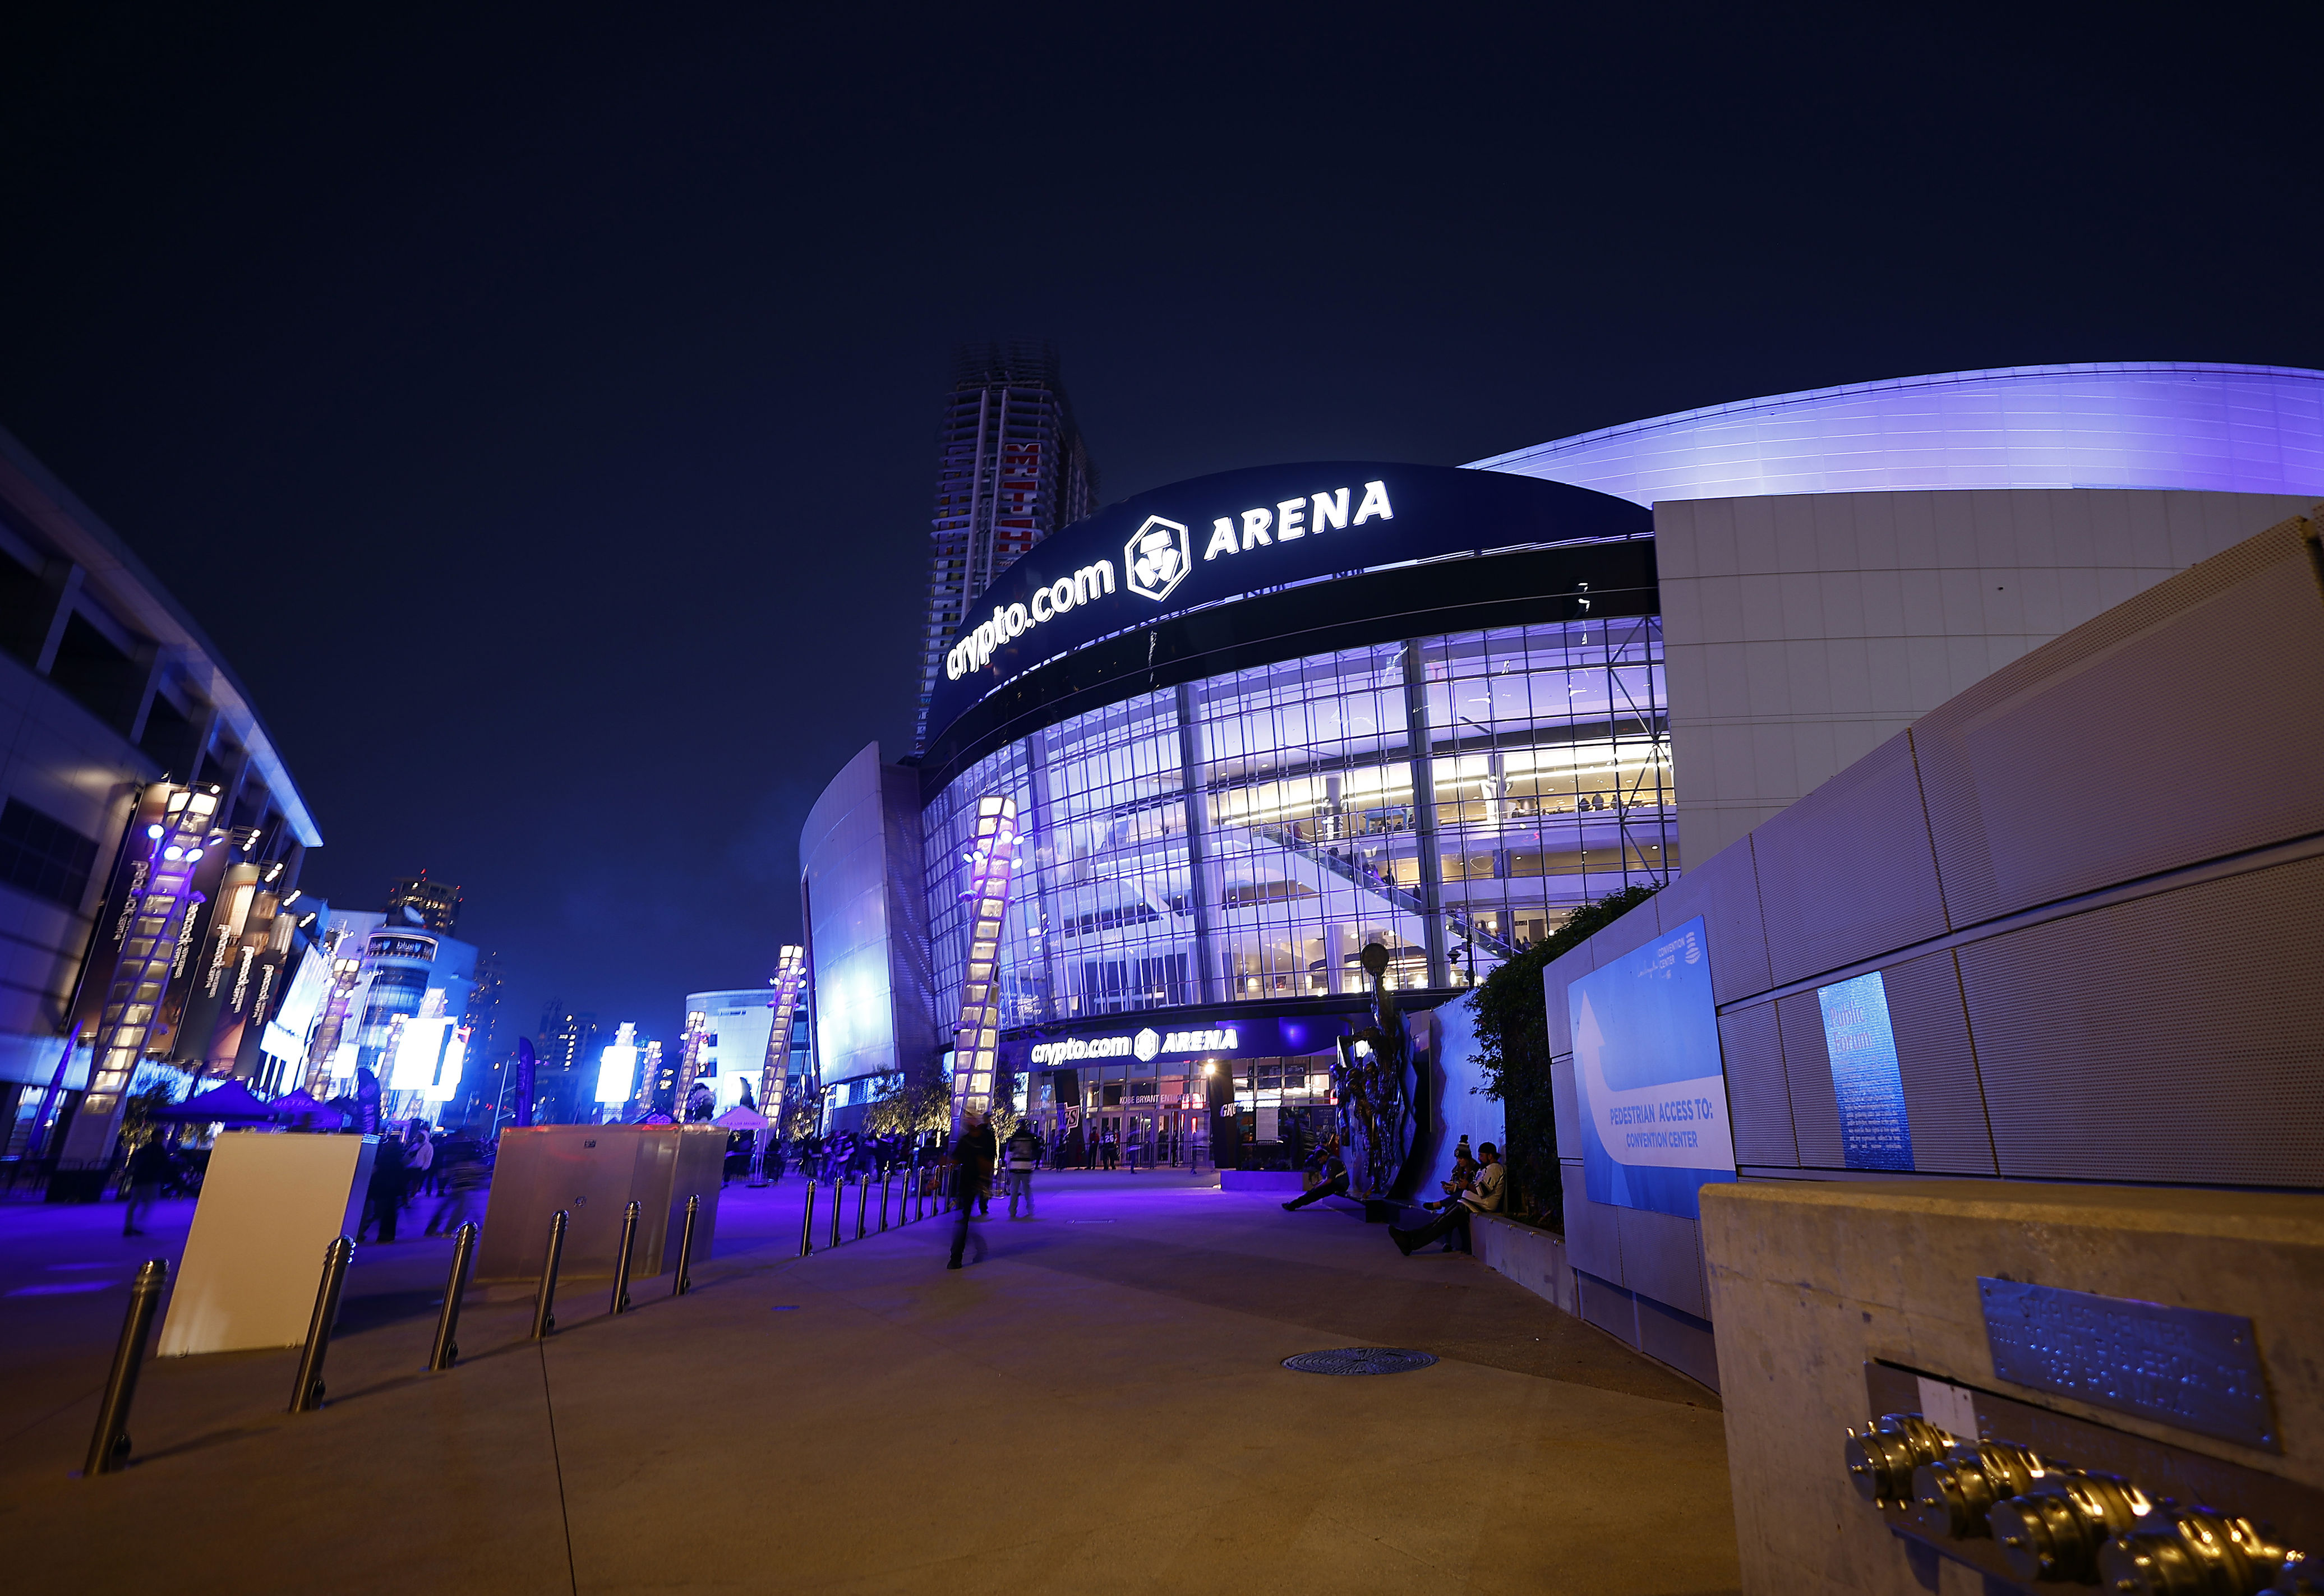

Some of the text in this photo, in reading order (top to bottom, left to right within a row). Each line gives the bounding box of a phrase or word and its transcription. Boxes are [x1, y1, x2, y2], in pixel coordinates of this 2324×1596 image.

[947, 480, 1394, 680] crypto.com ARENA
[177, 901, 200, 946] eacock
[211, 924, 231, 971] peacock
[395, 940, 415, 952] blue
[1658, 936, 1685, 957] CONVENTION
[236, 945, 255, 988] peacock
[1659, 954, 1676, 969] CENTER
[1829, 1000, 1865, 1028] Public
[1031, 1028, 1238, 1066] crypto.com ARENA
[1119, 1096, 1135, 1104] KOBE
[1136, 1095, 1159, 1104] BRYANT
[1610, 1097, 1714, 1125] PEDESTRIAN ACCESS TO:
[1626, 1131, 1698, 1147] CONVENTION CENTER
[2105, 1311, 2192, 1350] CENTER
